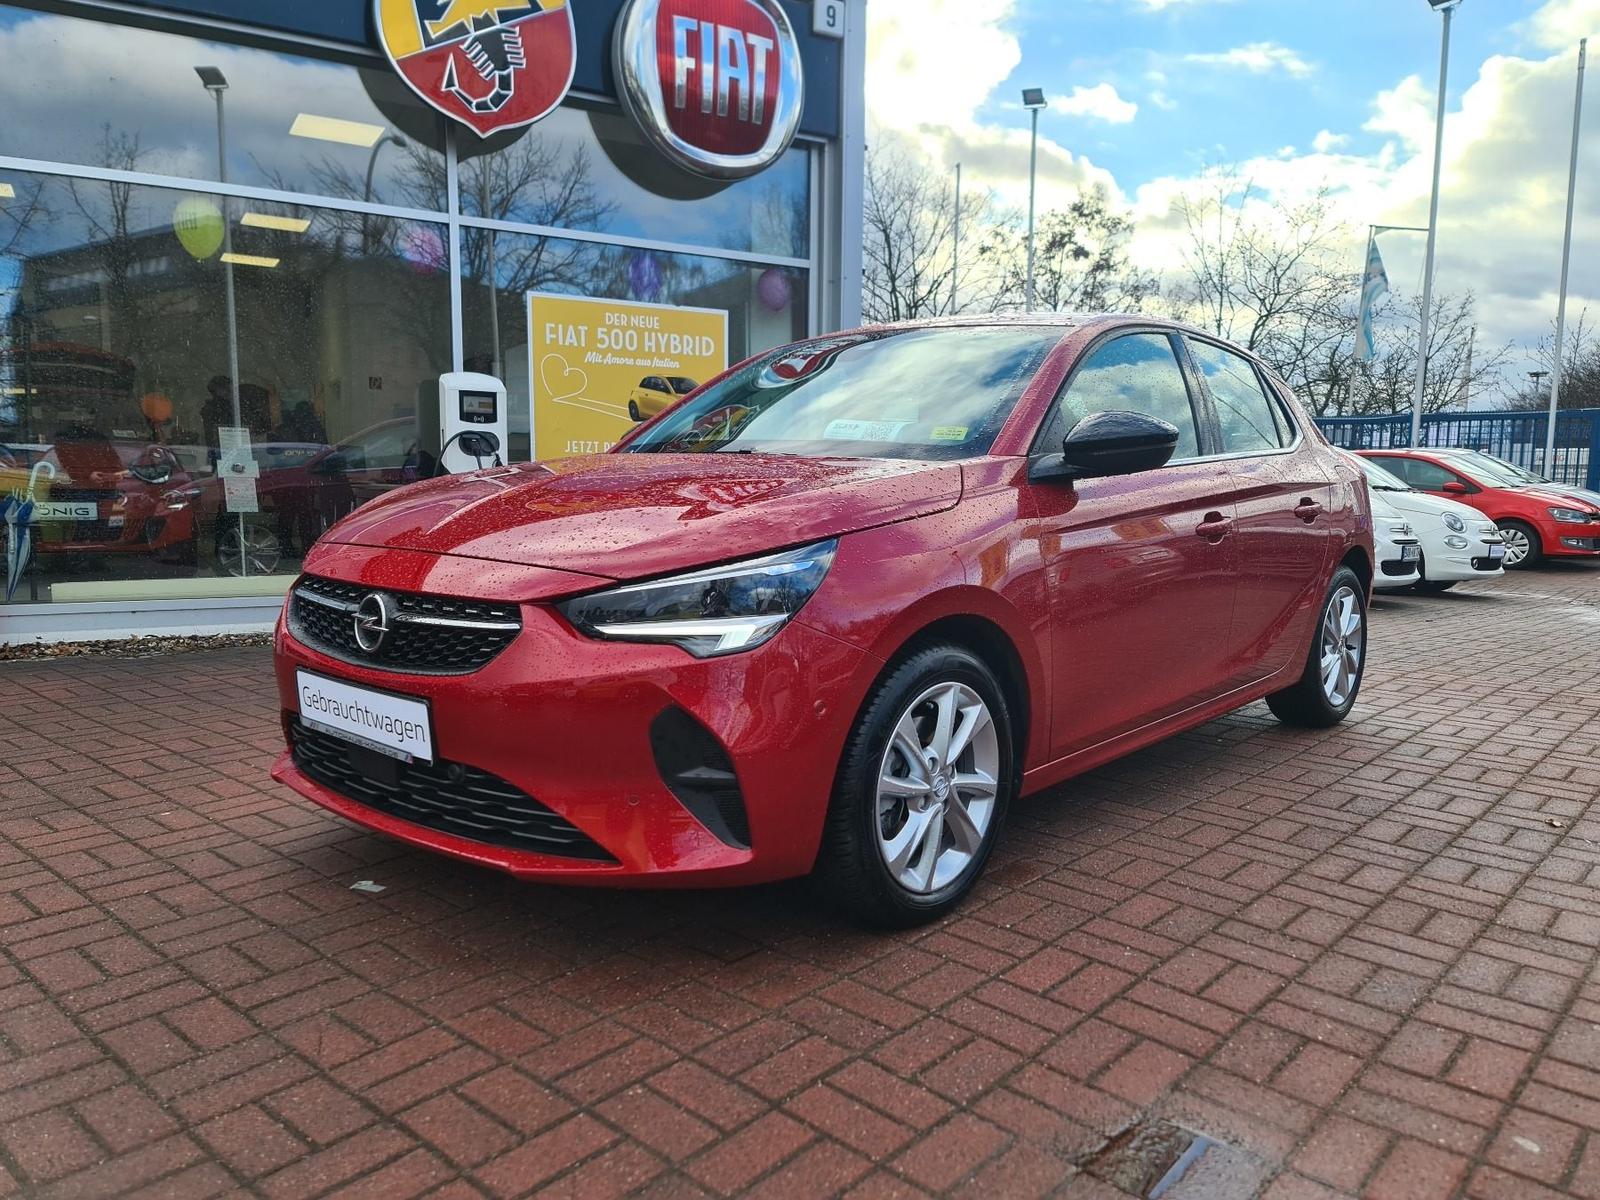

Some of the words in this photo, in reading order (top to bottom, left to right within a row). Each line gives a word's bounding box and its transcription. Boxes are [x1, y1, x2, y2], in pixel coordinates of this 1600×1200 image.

[826, 4, 836, 28] 9
[672, 14, 773, 125] FIAT
[605, 311, 628, 327] DER
[630, 315, 660, 329] NEUE
[545, 323, 588, 348] FIAT
[597, 327, 638, 351] 500
[644, 331, 715, 357] HYBRID
[584, 351, 602, 364] Mit
[603, 352, 634, 366] Amore
[635, 359, 651, 367] aus
[565, 440, 599, 454] JETZT
[36, 503, 90, 516] ÖNIG
[302, 685, 426, 743] Gebrauchtwagen
